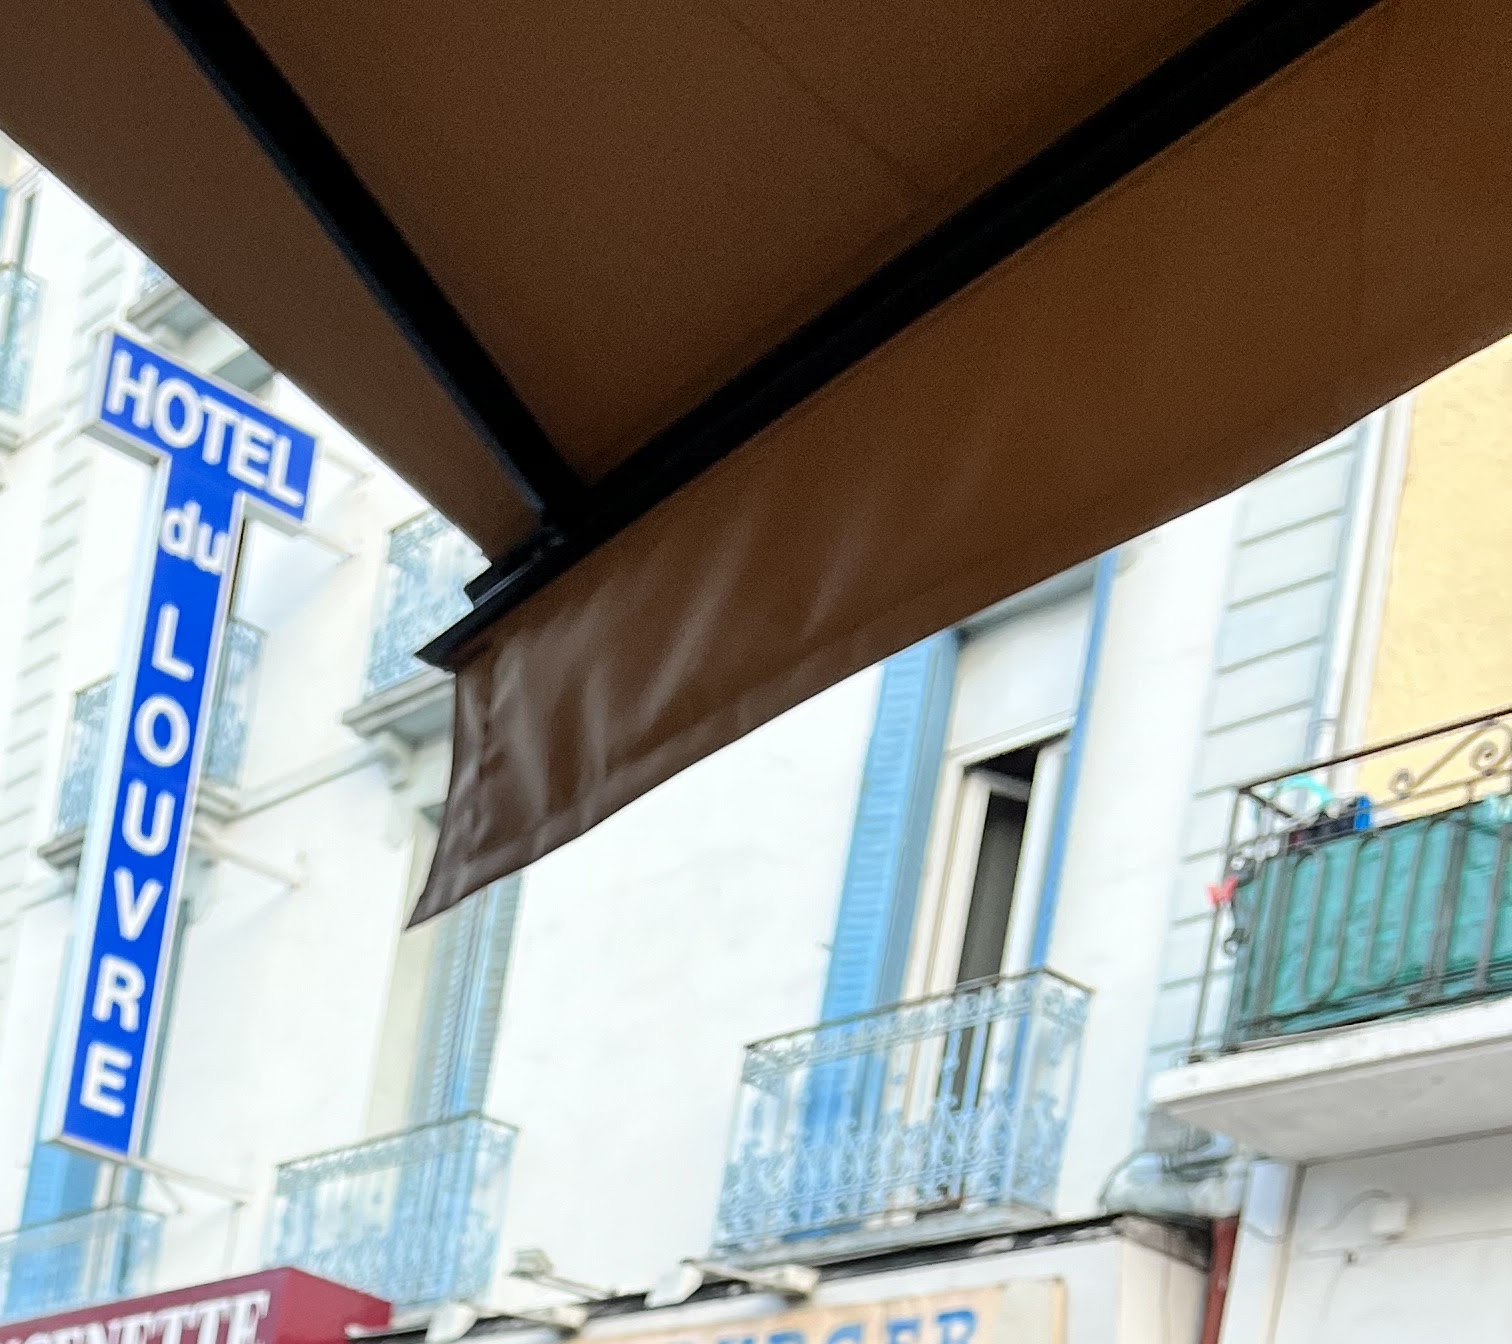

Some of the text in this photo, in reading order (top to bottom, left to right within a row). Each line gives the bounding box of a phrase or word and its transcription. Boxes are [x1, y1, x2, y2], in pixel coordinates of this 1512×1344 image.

[105, 348, 305, 508] HOTEL
[159, 499, 229, 576] du
[79, 602, 195, 1118] LOUVRE
